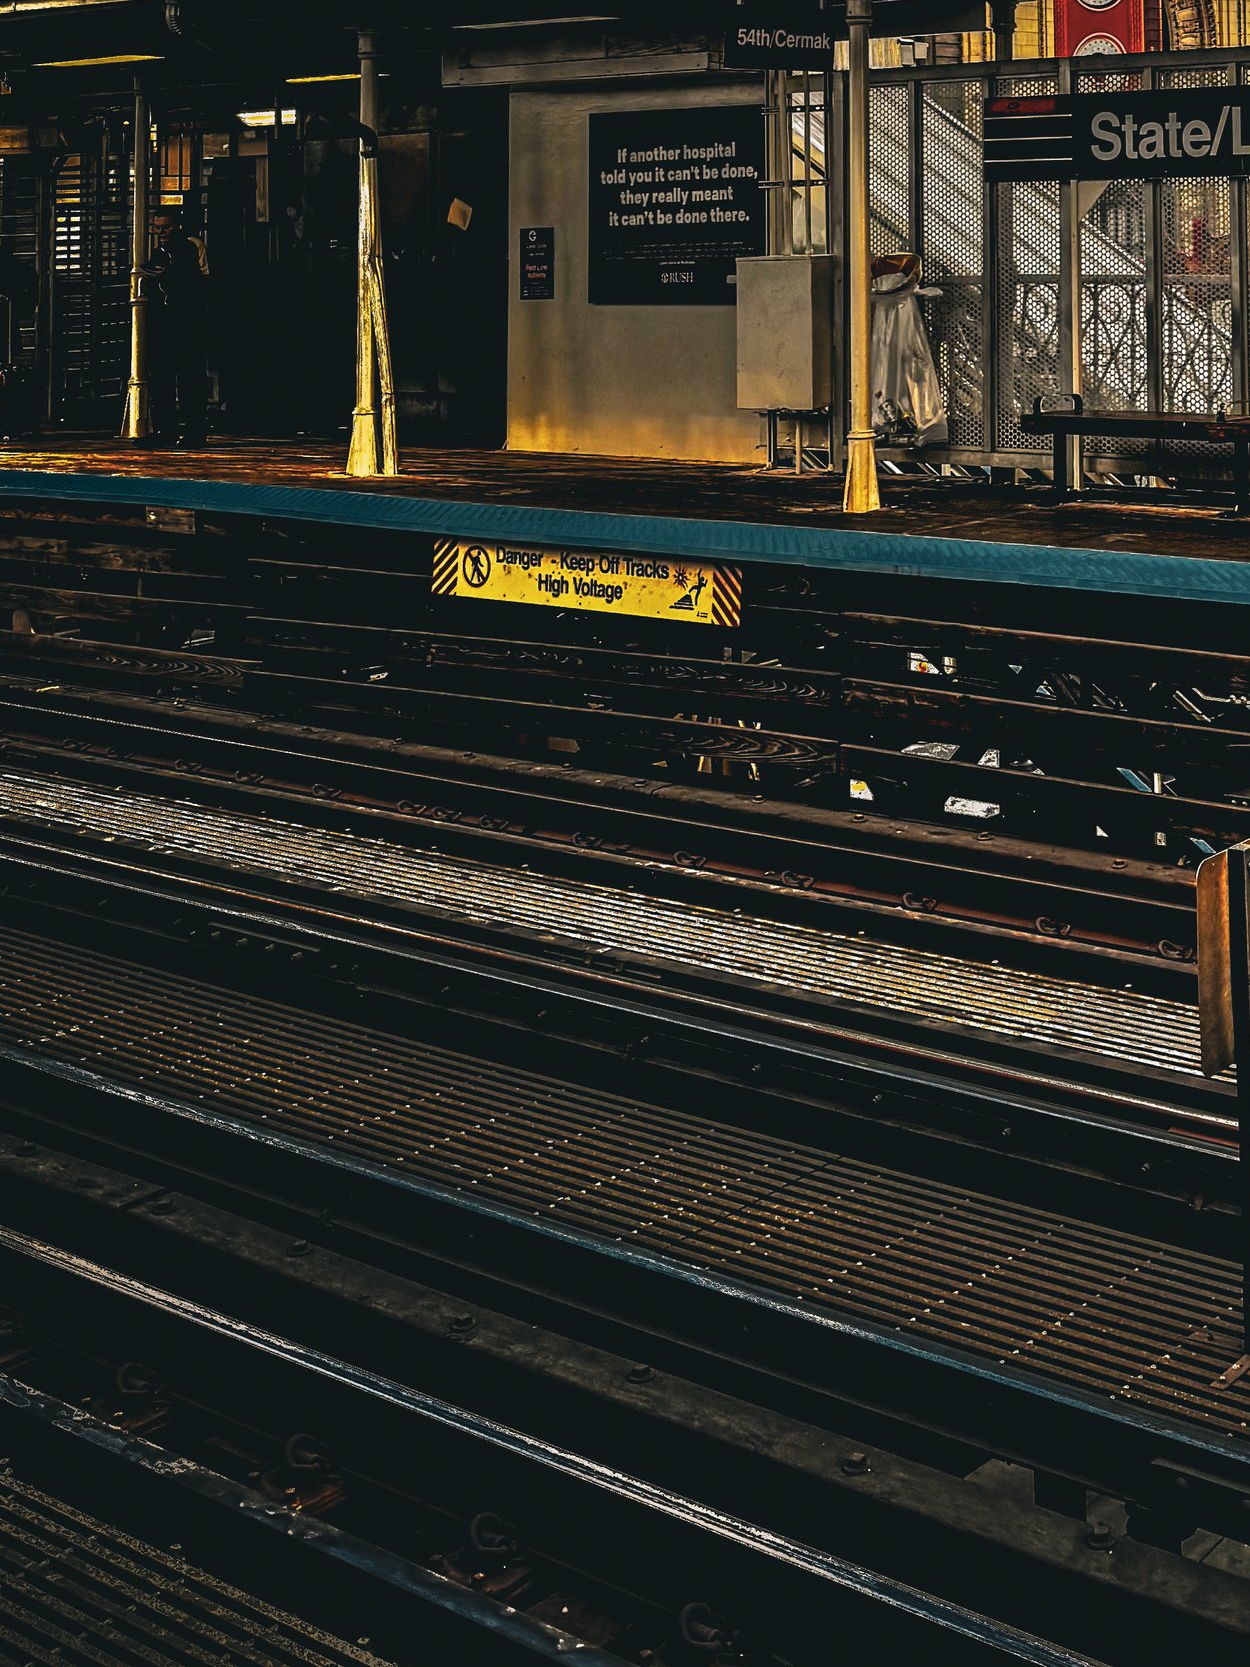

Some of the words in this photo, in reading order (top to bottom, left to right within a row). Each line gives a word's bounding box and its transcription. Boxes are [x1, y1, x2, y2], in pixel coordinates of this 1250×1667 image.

[737, 28, 831, 50] 54th/Cermak
[617, 148, 628, 164] If
[629, 145, 681, 163] another
[683, 141, 736, 162] hospital
[600, 169, 626, 185] told
[628, 171, 653, 187] you
[655, 167, 666, 182] it
[667, 165, 700, 182] can't
[702, 164, 719, 180] be
[721, 163, 758, 180] done,
[619, 189, 650, 207] they
[652, 187, 690, 206] really
[691, 186, 734, 203] meant
[609, 211, 620, 227] it
[656, 209, 673, 226] be
[675, 208, 708, 225] done
[709, 207, 751, 223] there.
[669, 271, 695, 283] RUSH
[495, 545, 545, 568] Danger
[559, 550, 595, 577] Keep
[598, 555, 621, 575] Off
[622, 556, 670, 580] Tracks
[537, 573, 570, 598] High
[572, 577, 624, 604] Voltage
